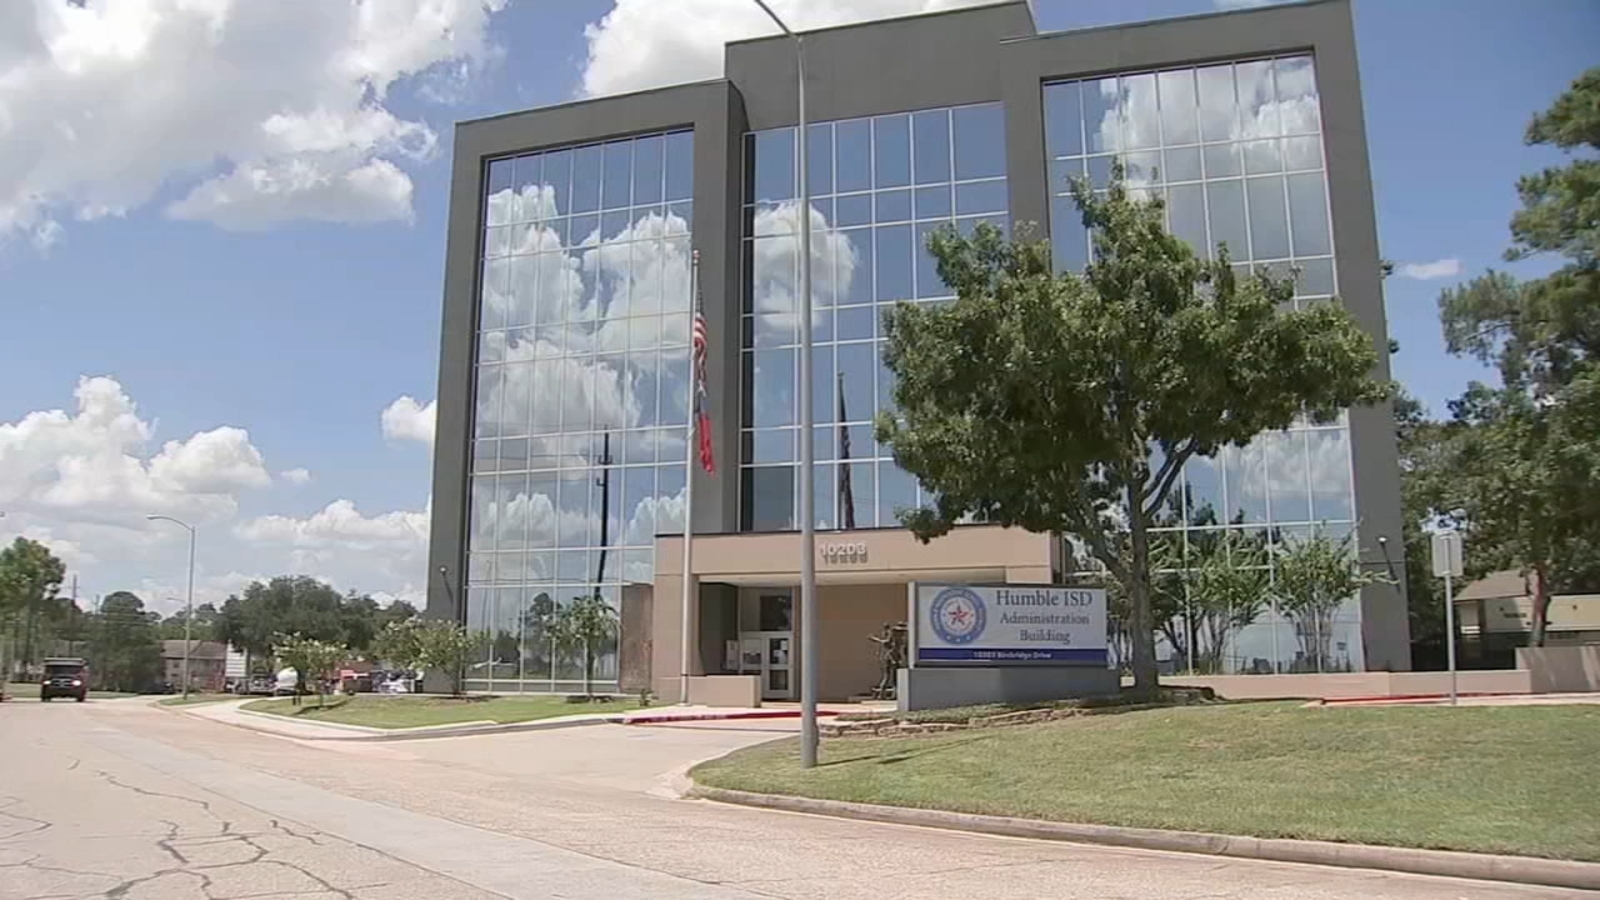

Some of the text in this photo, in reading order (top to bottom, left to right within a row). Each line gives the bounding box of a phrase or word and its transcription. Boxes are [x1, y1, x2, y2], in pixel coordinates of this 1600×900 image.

[820, 542, 868, 556] 10203
[996, 589, 1093, 607] Humble ISD
[1000, 612, 1090, 625] Administration
[1019, 629, 1071, 645] Building
